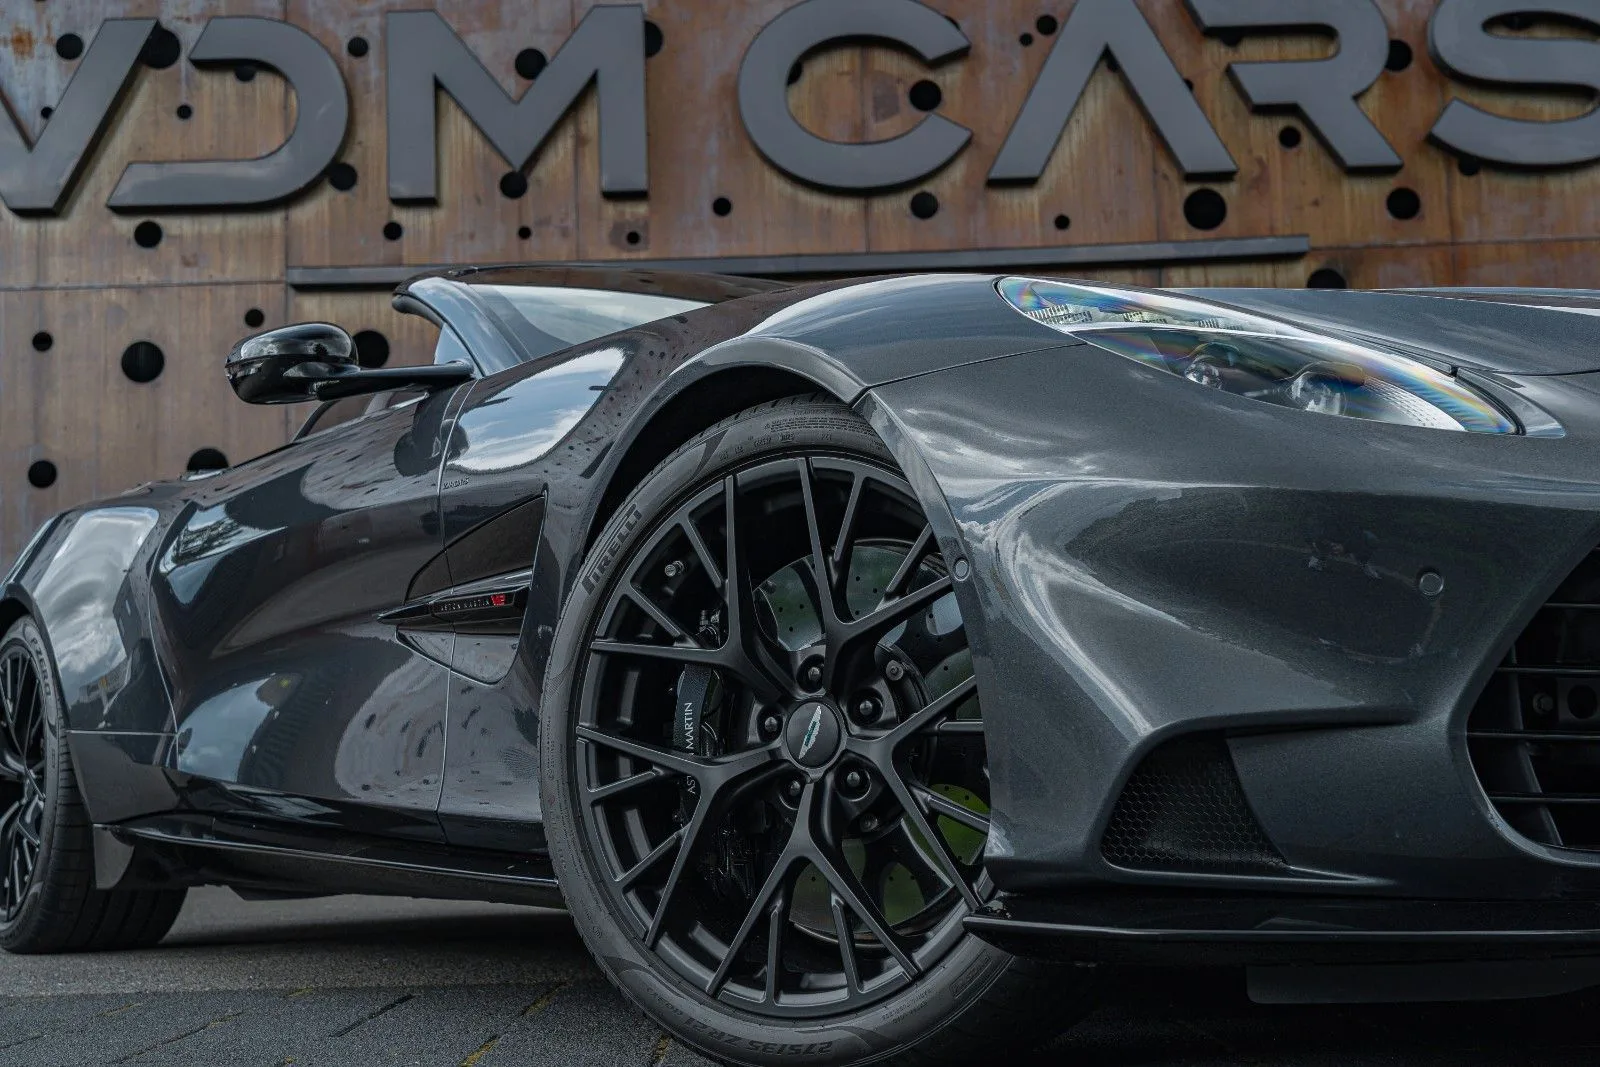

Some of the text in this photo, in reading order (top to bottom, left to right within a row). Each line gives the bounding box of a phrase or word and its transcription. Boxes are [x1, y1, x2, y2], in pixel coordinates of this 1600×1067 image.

[0, 0, 1600, 214] VDM CARS
[581, 503, 643, 595] PIRELLI
[35, 646, 52, 697] ZERO
[684, 702, 694, 750] MARTIN
[747, 1039, 833, 1057] 275/35
